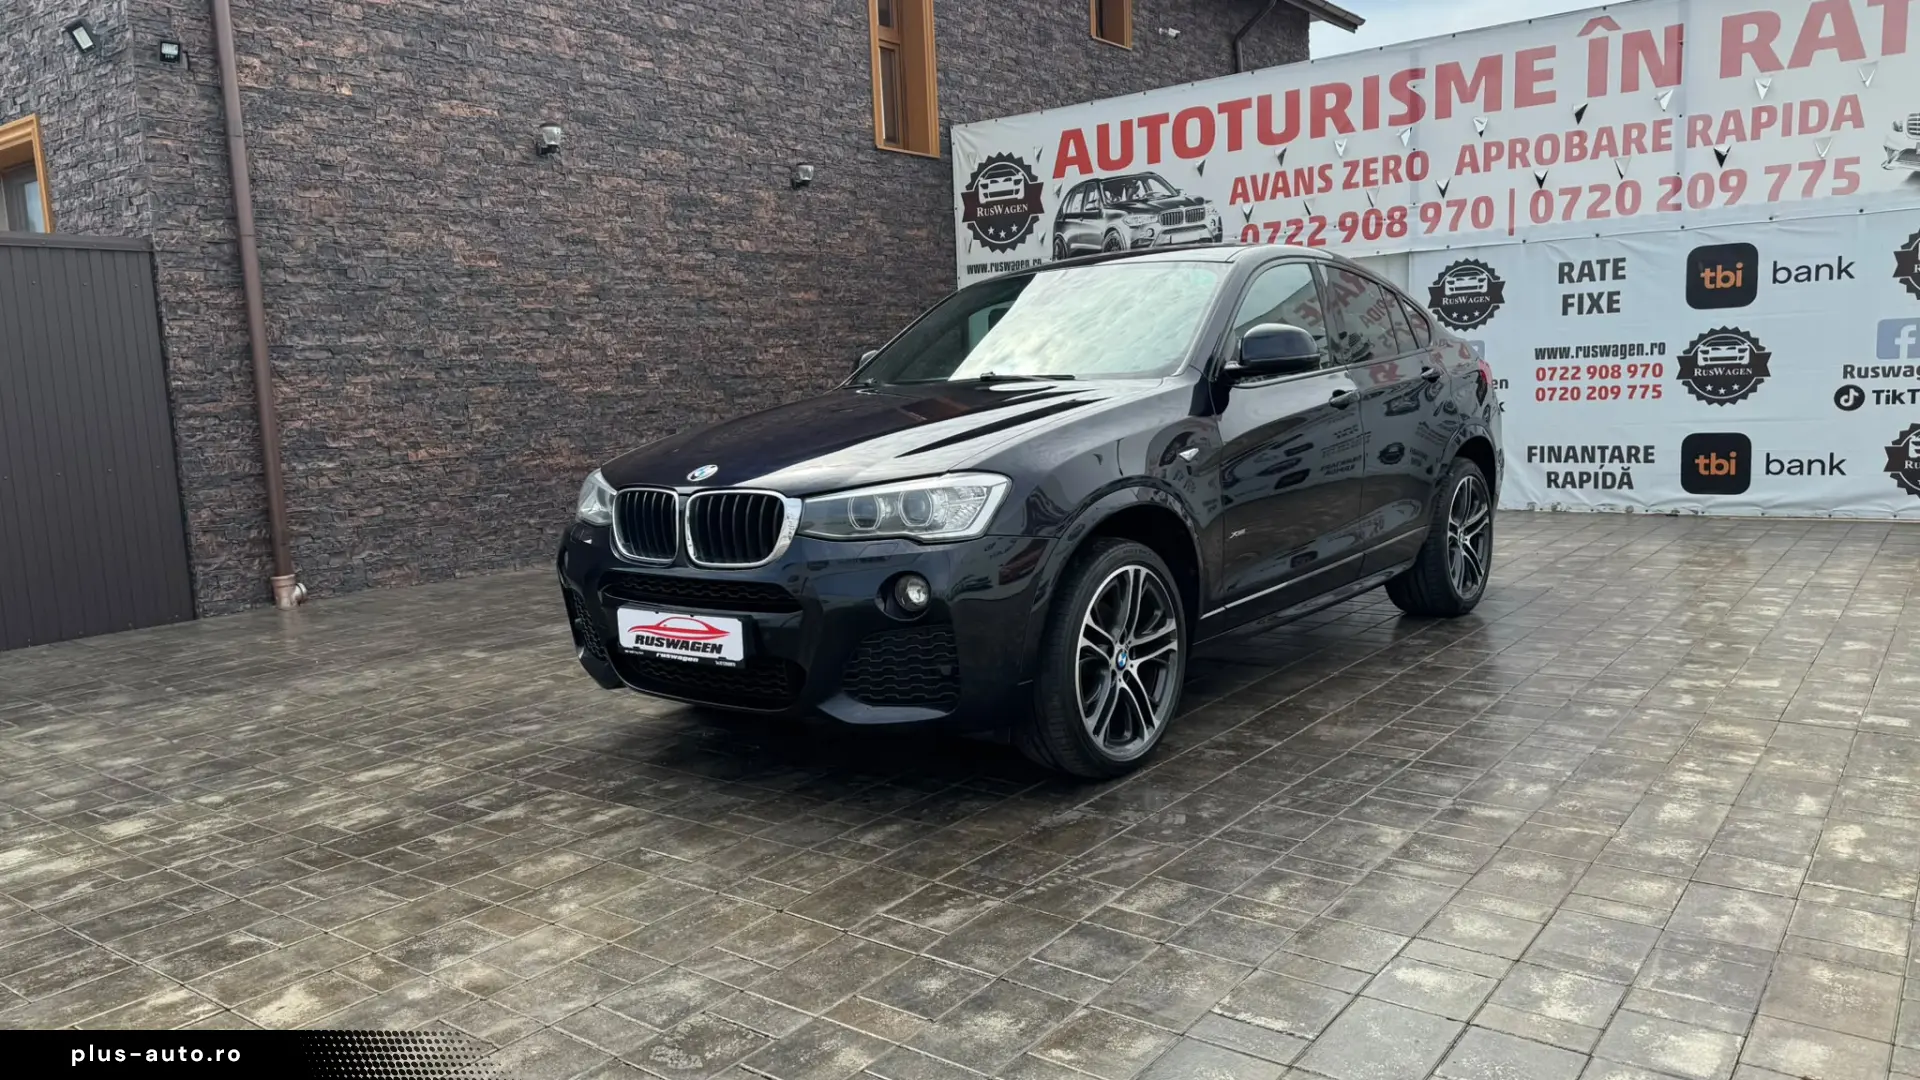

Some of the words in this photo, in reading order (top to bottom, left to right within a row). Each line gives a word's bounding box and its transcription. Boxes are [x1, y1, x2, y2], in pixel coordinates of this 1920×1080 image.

[1052, 45, 1557, 179] AUTOTURISME
[1577, 15, 1685, 99] ÎN
[1228, 163, 1333, 206] AVANS
[1342, 149, 1430, 190] ZERO
[1454, 118, 1673, 176] APROBARE
[1686, 94, 1865, 149] RAPIDA
[1240, 214, 1328, 247] 0722
[1337, 205, 1408, 243] 908
[1419, 195, 1494, 235] 970
[1528, 180, 1642, 224] 0720
[1656, 168, 1748, 212] 209
[1764, 155, 1861, 203] 775
[1557, 257, 1627, 285] RATE
[1700, 262, 1744, 291] tbi
[1772, 255, 1855, 285] bank
[1561, 290, 1621, 316] FIXE
[1534, 341, 1667, 361] www.ruswagen.ro
[1535, 365, 1582, 382] 0722
[1586, 364, 1623, 381] 908
[1626, 363, 1664, 380] 970
[1535, 386, 1581, 402] 0720
[1586, 385, 1622, 401] 209
[1626, 384, 1663, 400] 775
[1526, 445, 1656, 471] FINANȚARE
[1694, 450, 1738, 476] tbi
[1764, 452, 1847, 476] bank
[1545, 464, 1635, 490] RAPIDĂ
[634, 634, 724, 655] RUSWAGEN
[656, 652, 699, 663] ruswagen
